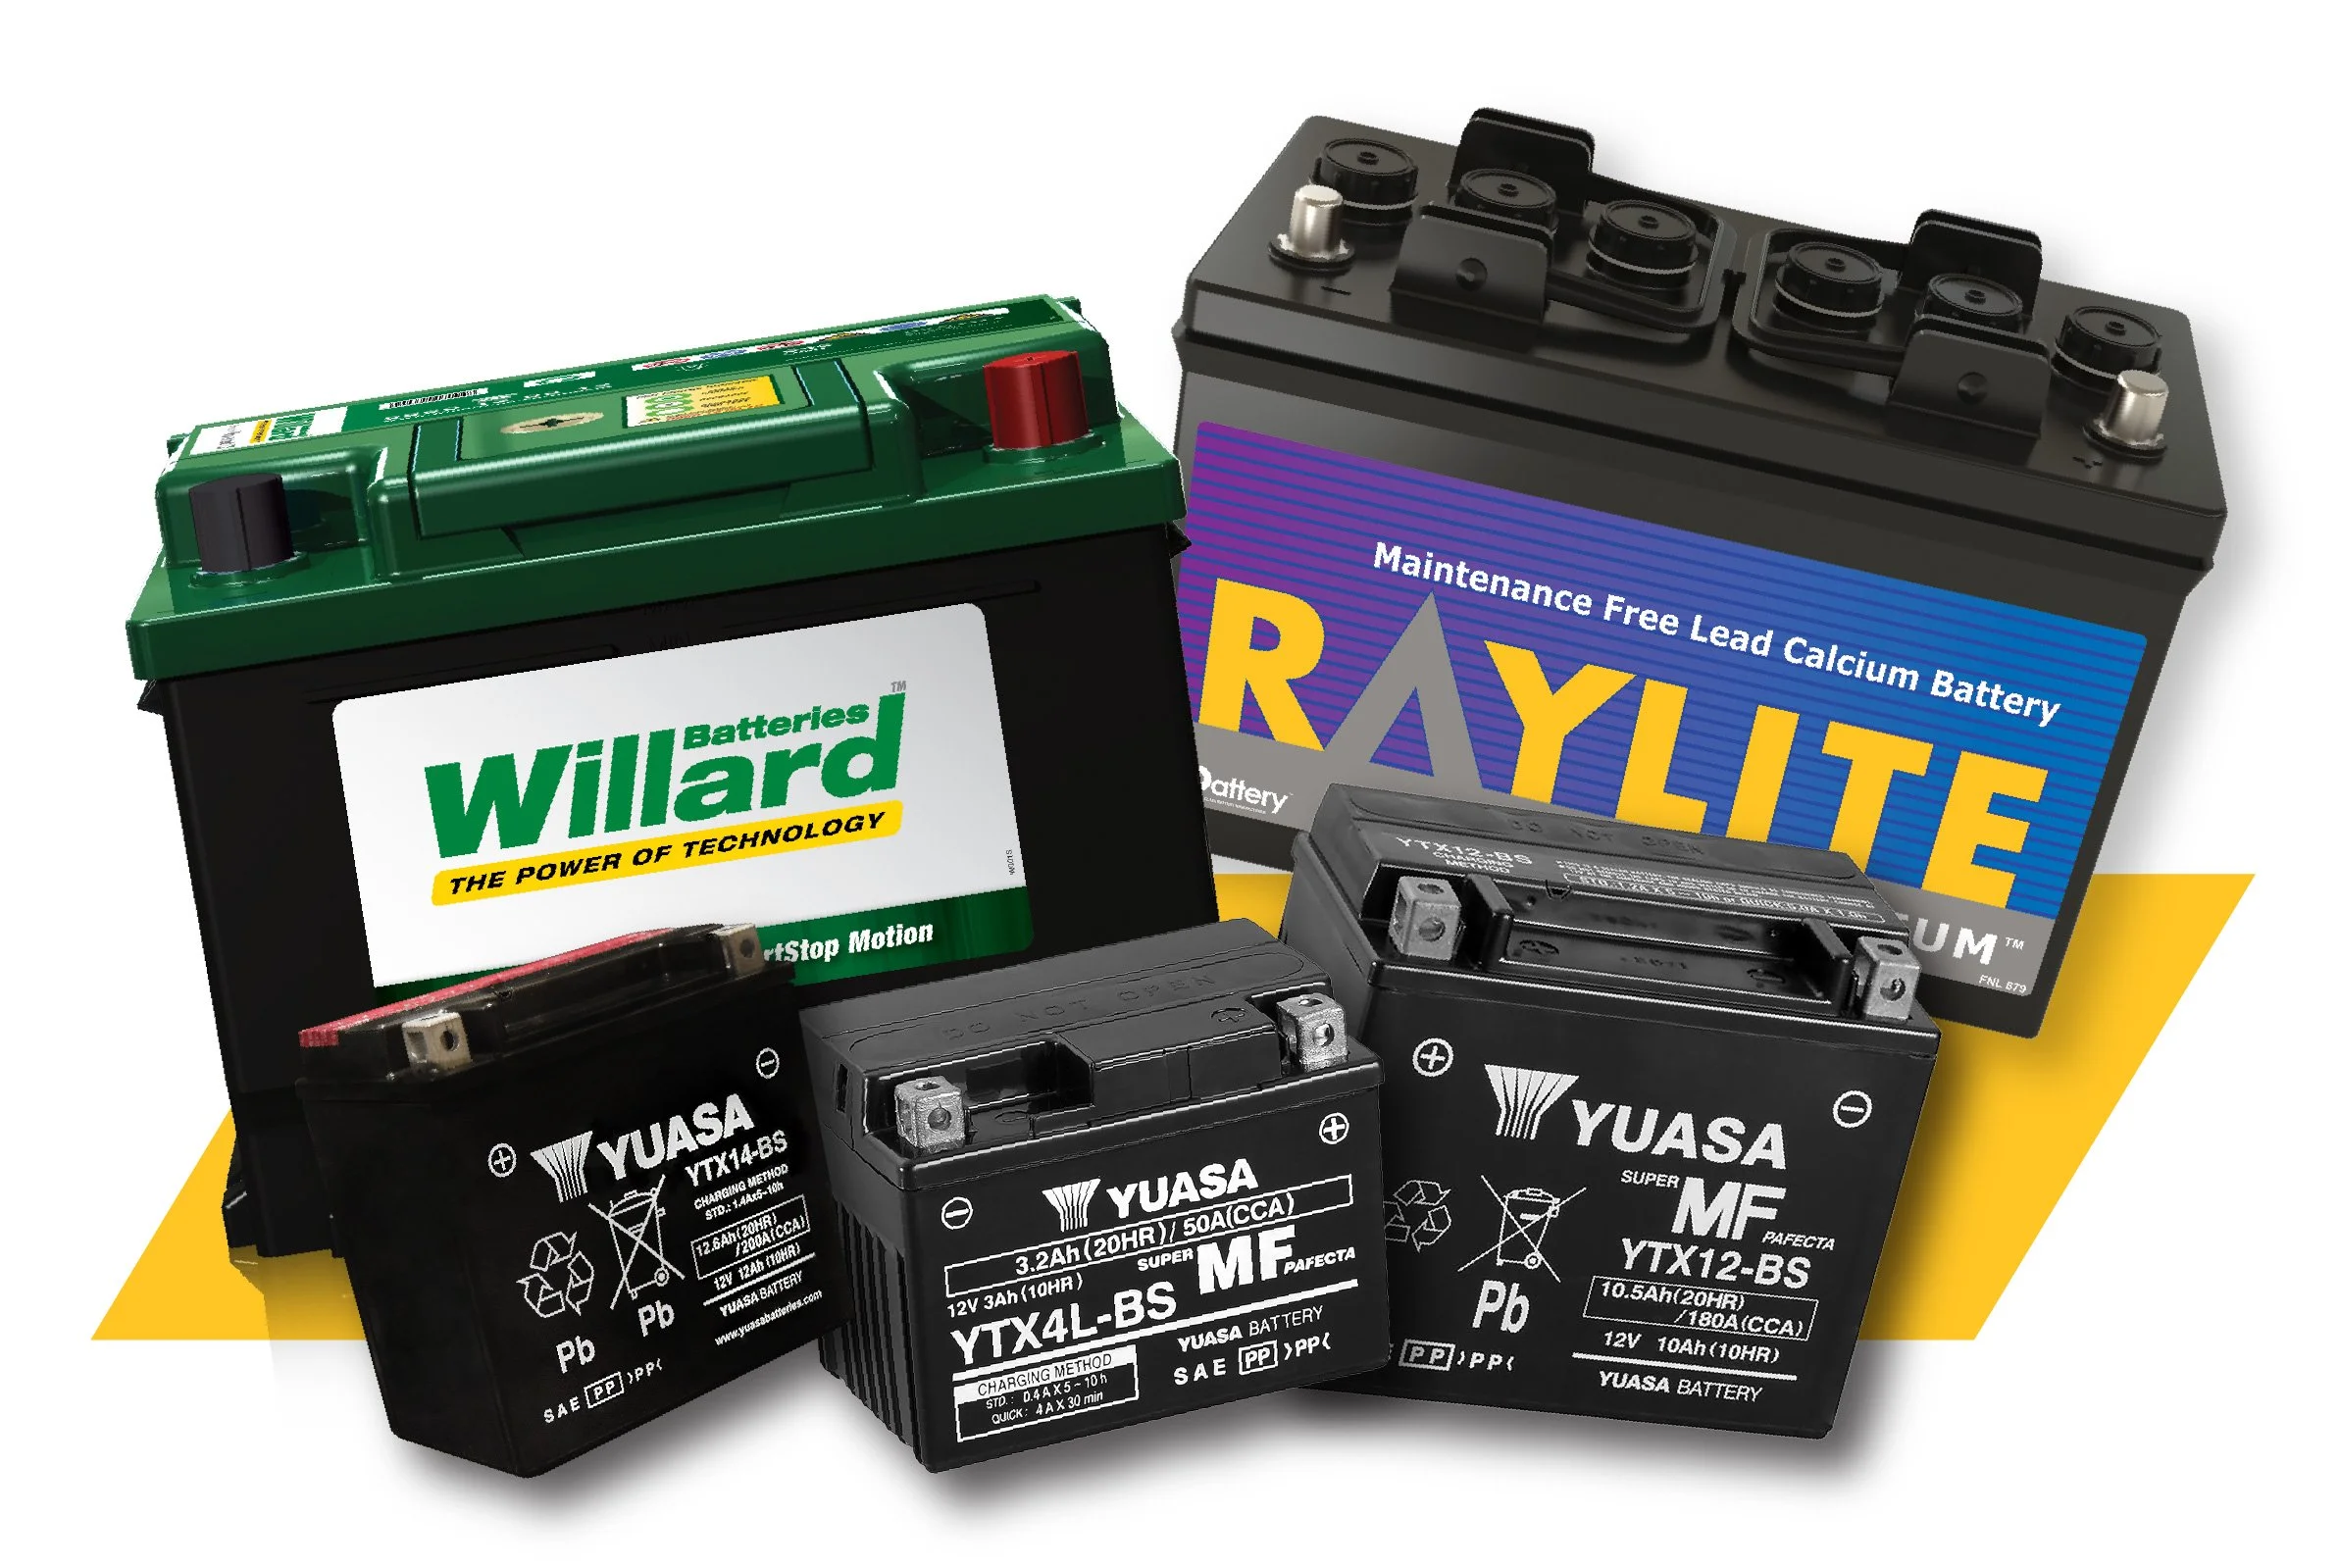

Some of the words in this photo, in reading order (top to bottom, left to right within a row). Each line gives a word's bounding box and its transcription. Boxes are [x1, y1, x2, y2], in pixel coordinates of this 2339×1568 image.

[1374, 542, 1592, 616] Maintenance
[1604, 594, 1679, 635] Free
[1690, 615, 1773, 657] Lead
[1784, 636, 1919, 690] Calcium
[1931, 670, 2060, 726] Battery
[684, 704, 869, 749] Batteries
[1197, 578, 2050, 908] RAYLITE
[425, 692, 905, 857] Willard
[450, 870, 505, 895] THE
[516, 853, 622, 885] POWER
[633, 845, 672, 866] OF
[684, 812, 886, 858] TECHNOLOGY
[1397, 837, 1532, 864] YTX12-BS
[764, 938, 839, 962] rtStop
[848, 924, 933, 953] Motion
[1896, 918, 1998, 965] UM
[1979, 975, 2002, 987] FNL
[596, 1093, 754, 1179] YUASA
[1572, 1099, 1786, 1169] YUASA
[685, 1130, 788, 1187] YTX14-BS
[694, 1182, 746, 1209] CHARGING
[747, 1164, 788, 1188] METHOD
[1106, 1159, 1258, 1218] YUASA
[1621, 1170, 1680, 1188] SUPER
[1671, 1176, 1787, 1239] MF
[1762, 1231, 1835, 1250] PAFECTA
[696, 1214, 777, 1256] 12.6Ah(20HR)
[714, 1272, 732, 1290] 12V
[1138, 1248, 1194, 1271] SUPER
[1197, 1225, 1295, 1294] MF
[1284, 1247, 1355, 1275] PAFECTA
[1622, 1239, 1810, 1289] YTX12-BS
[720, 1292, 759, 1316] YUASA
[759, 1271, 801, 1299] BATTERY
[947, 1297, 978, 1317] 12V
[1473, 1280, 1529, 1333] Pb
[1602, 1282, 1745, 1311] 10.5Ah(20HR)
[638, 1299, 675, 1337] Pb
[715, 1290, 822, 1345] www.yuasabatteries.com
[950, 1282, 1176, 1365] YTX4L-BS
[1177, 1326, 1243, 1351] YUASA
[1249, 1305, 1322, 1337] BATTERY
[1605, 1332, 1642, 1348] 12V
[1674, 1310, 1805, 1340] /180A(CCA)
[556, 1336, 595, 1373] Pb
[978, 1369, 1049, 1395] CHARGING
[1054, 1354, 1111, 1378] METHOD
[1068, 1395, 1080, 1408] 30
[1085, 1391, 1102, 1404] min
[1600, 1371, 1669, 1392] YUASA
[1677, 1380, 1762, 1402] BATTERY
